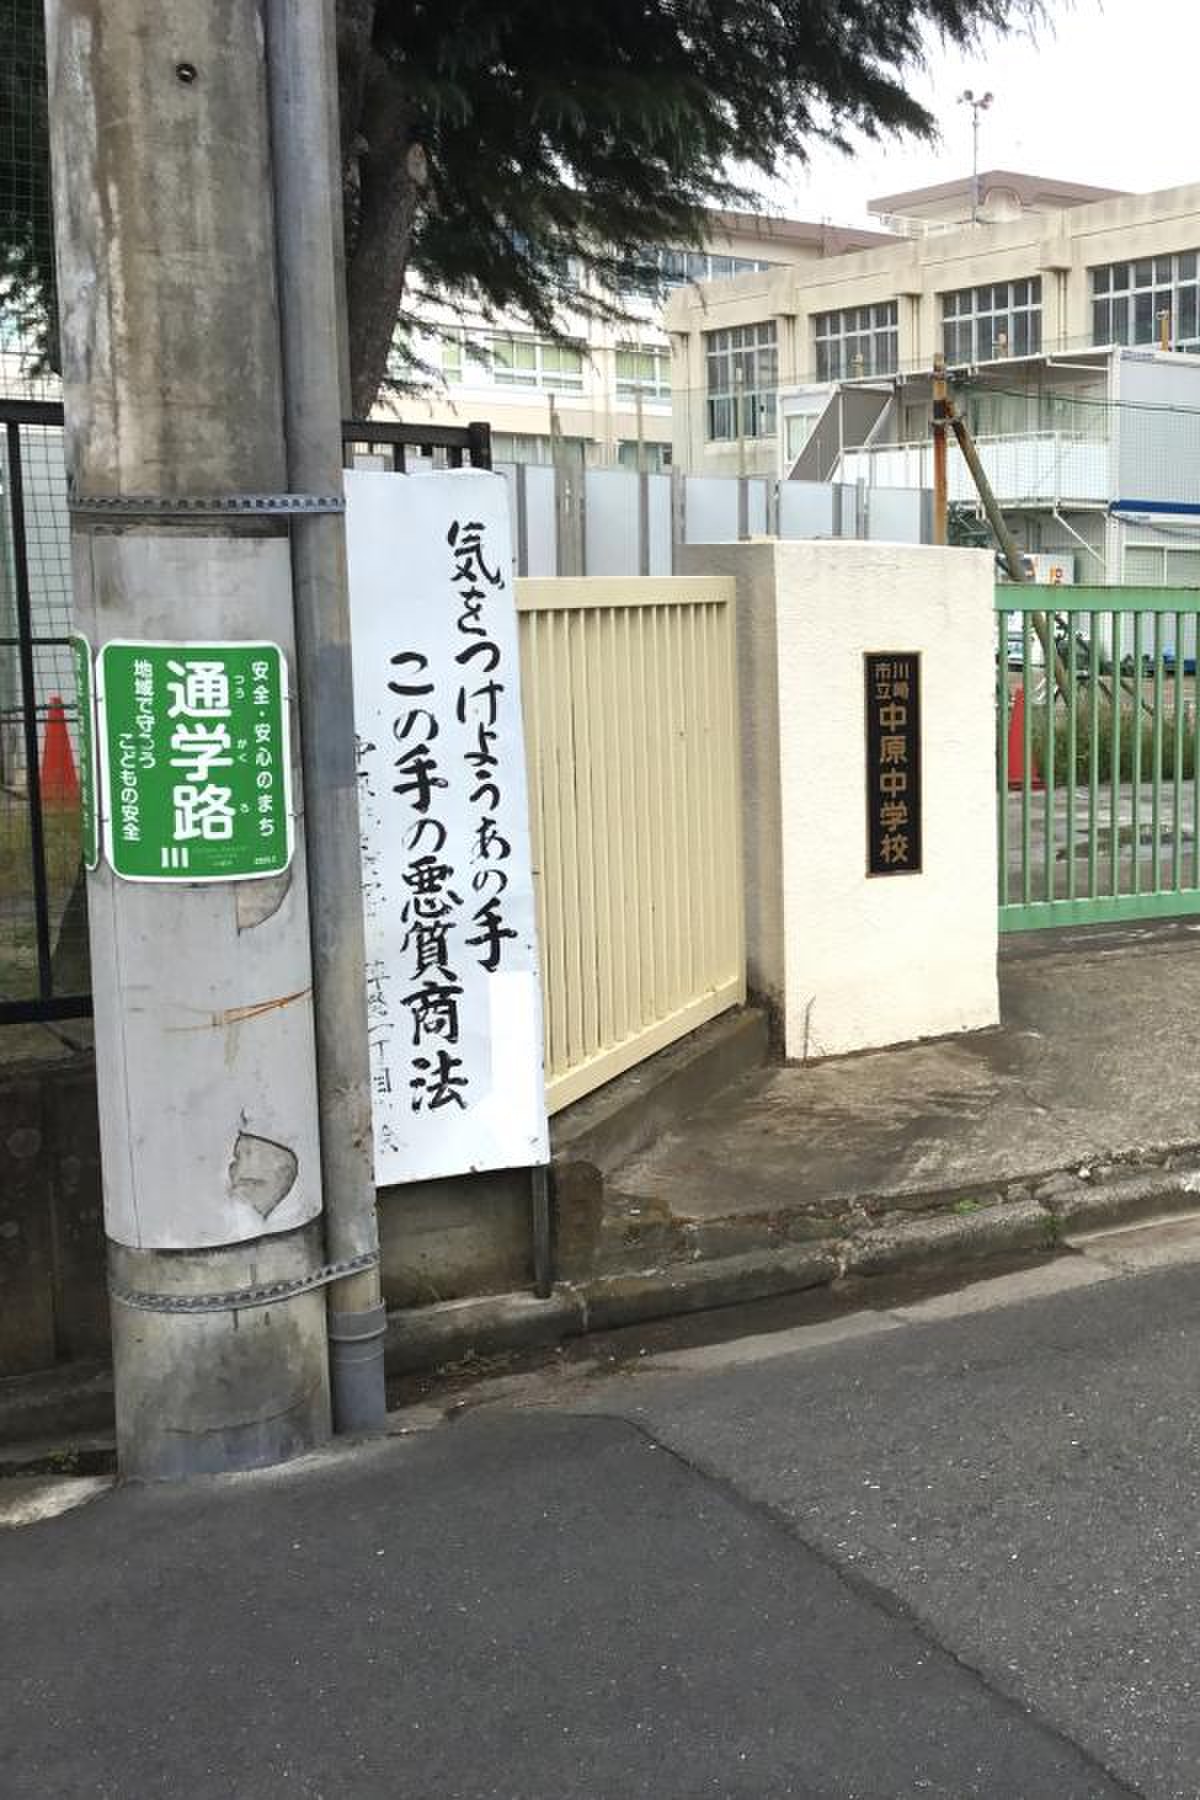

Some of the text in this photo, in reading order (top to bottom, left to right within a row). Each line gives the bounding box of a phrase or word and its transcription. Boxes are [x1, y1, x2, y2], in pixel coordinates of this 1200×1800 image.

[166, 659, 236, 841] 通学路
[252, 660, 273, 837] 安全・安心のまち
[447, 520, 518, 973] 気をつけようあの手
[879, 702, 909, 864] 中原中学校
[387, 651, 469, 1111] この手の悪質商法
